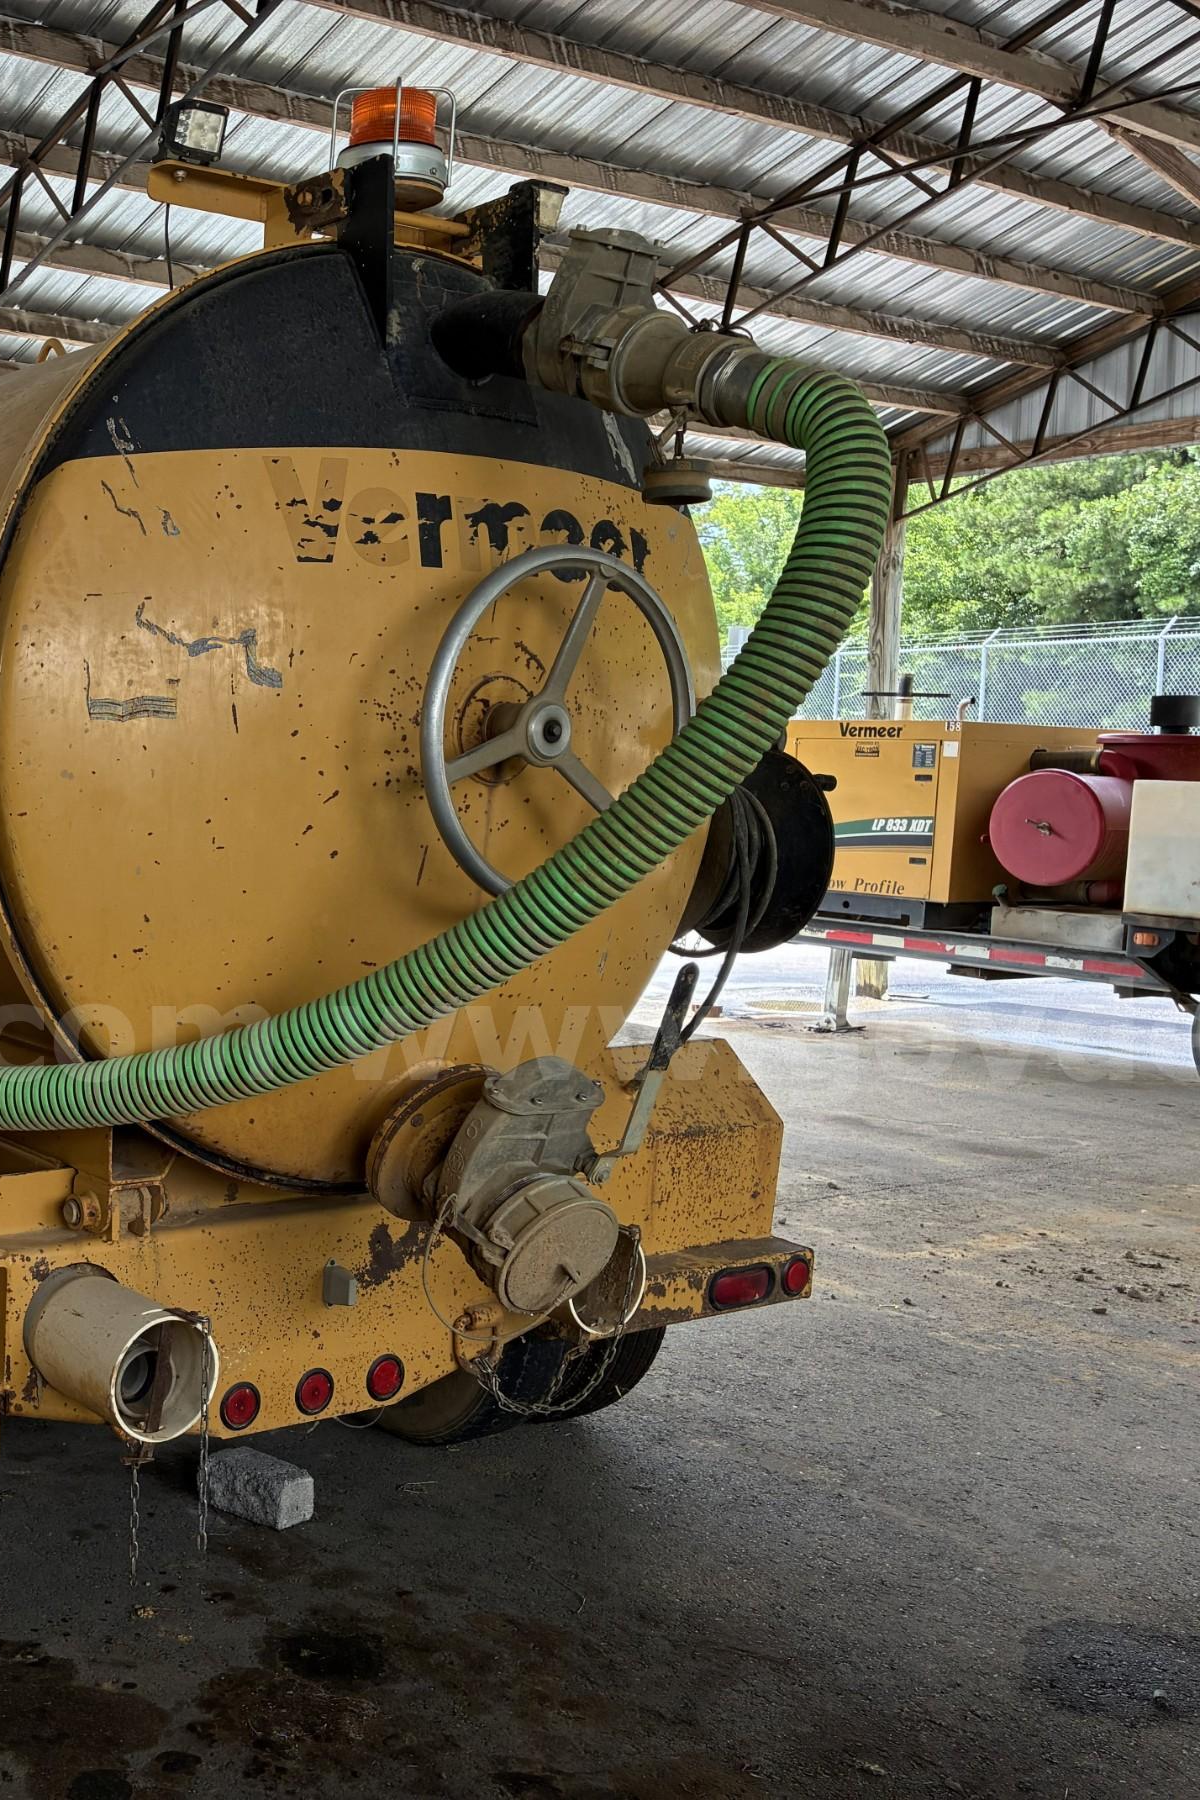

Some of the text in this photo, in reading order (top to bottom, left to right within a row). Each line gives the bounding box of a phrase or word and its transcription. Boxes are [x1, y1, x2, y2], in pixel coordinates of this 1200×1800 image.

[262, 455, 650, 592] Vermeer
[840, 722, 903, 738] Vermeer
[872, 819, 932, 832] LP 833 XDT
[829, 878, 905, 895] ow Profile
